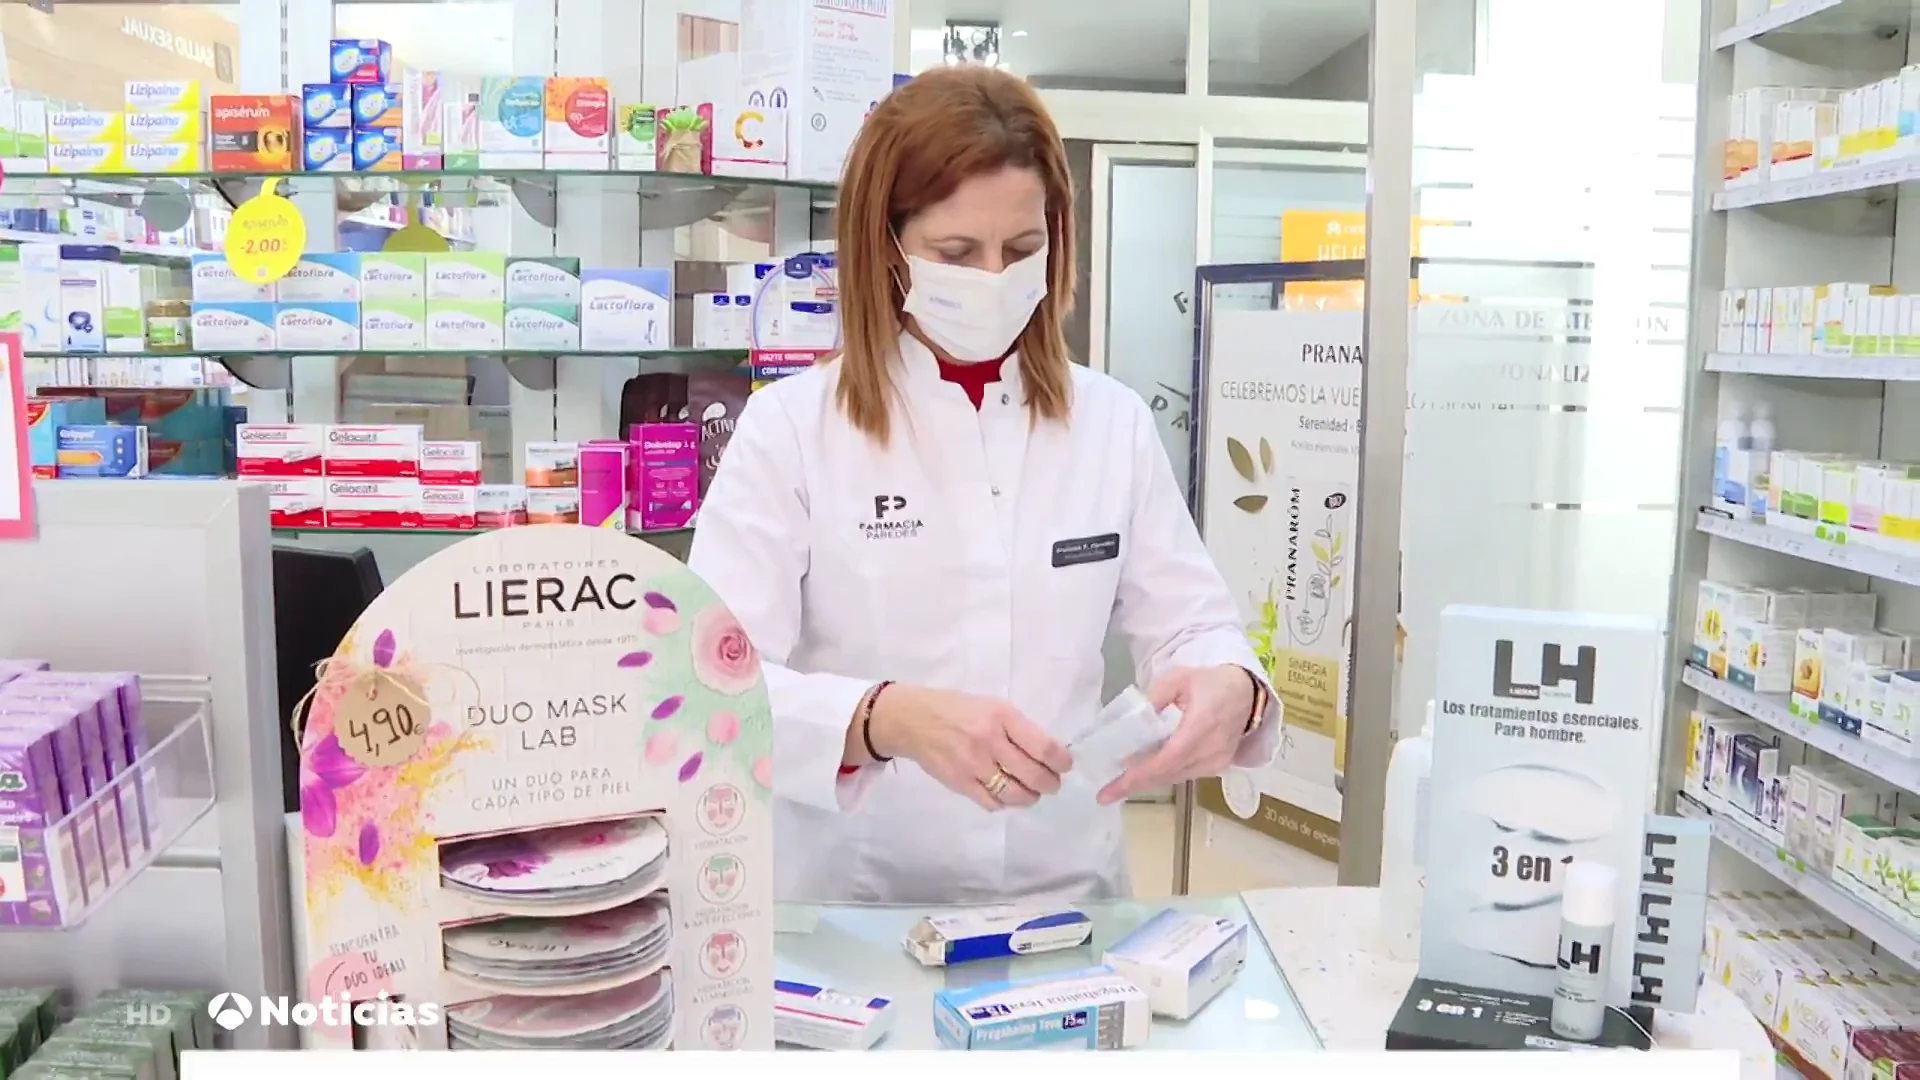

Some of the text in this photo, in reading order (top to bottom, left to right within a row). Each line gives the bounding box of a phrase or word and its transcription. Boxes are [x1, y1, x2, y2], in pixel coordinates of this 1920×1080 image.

[588, 299, 655, 312] Lactoflora
[1220, 380, 1306, 404] CELEBREMOS
[1310, 384, 1327, 405] LA
[1298, 415, 1348, 433] Serenidad
[329, 431, 378, 443] Gelocatil
[329, 483, 379, 495] Gelocatil
[858, 518, 925, 533] FARMACIA
[472, 558, 622, 575] LABORATOIRES
[453, 573, 638, 621] LIERAC
[522, 618, 576, 630] PARIS
[586, 636, 613, 648] desde
[1287, 655, 1328, 678] SINERGIA
[1493, 639, 1597, 705] LH
[1287, 669, 1328, 695] ESENCIAL
[468, 693, 628, 726] DUO MASK
[1442, 698, 1643, 735] Los tratamientos esenciales.
[522, 725, 577, 751] LAB
[1494, 721, 1587, 748] Para hombre.
[492, 776, 517, 792] UN
[571, 767, 612, 783] PARA
[471, 781, 632, 811] CADA TIPO DE PIEL
[1491, 845, 1509, 882] 3
[1516, 851, 1552, 882] en
[362, 948, 379, 965] TU
